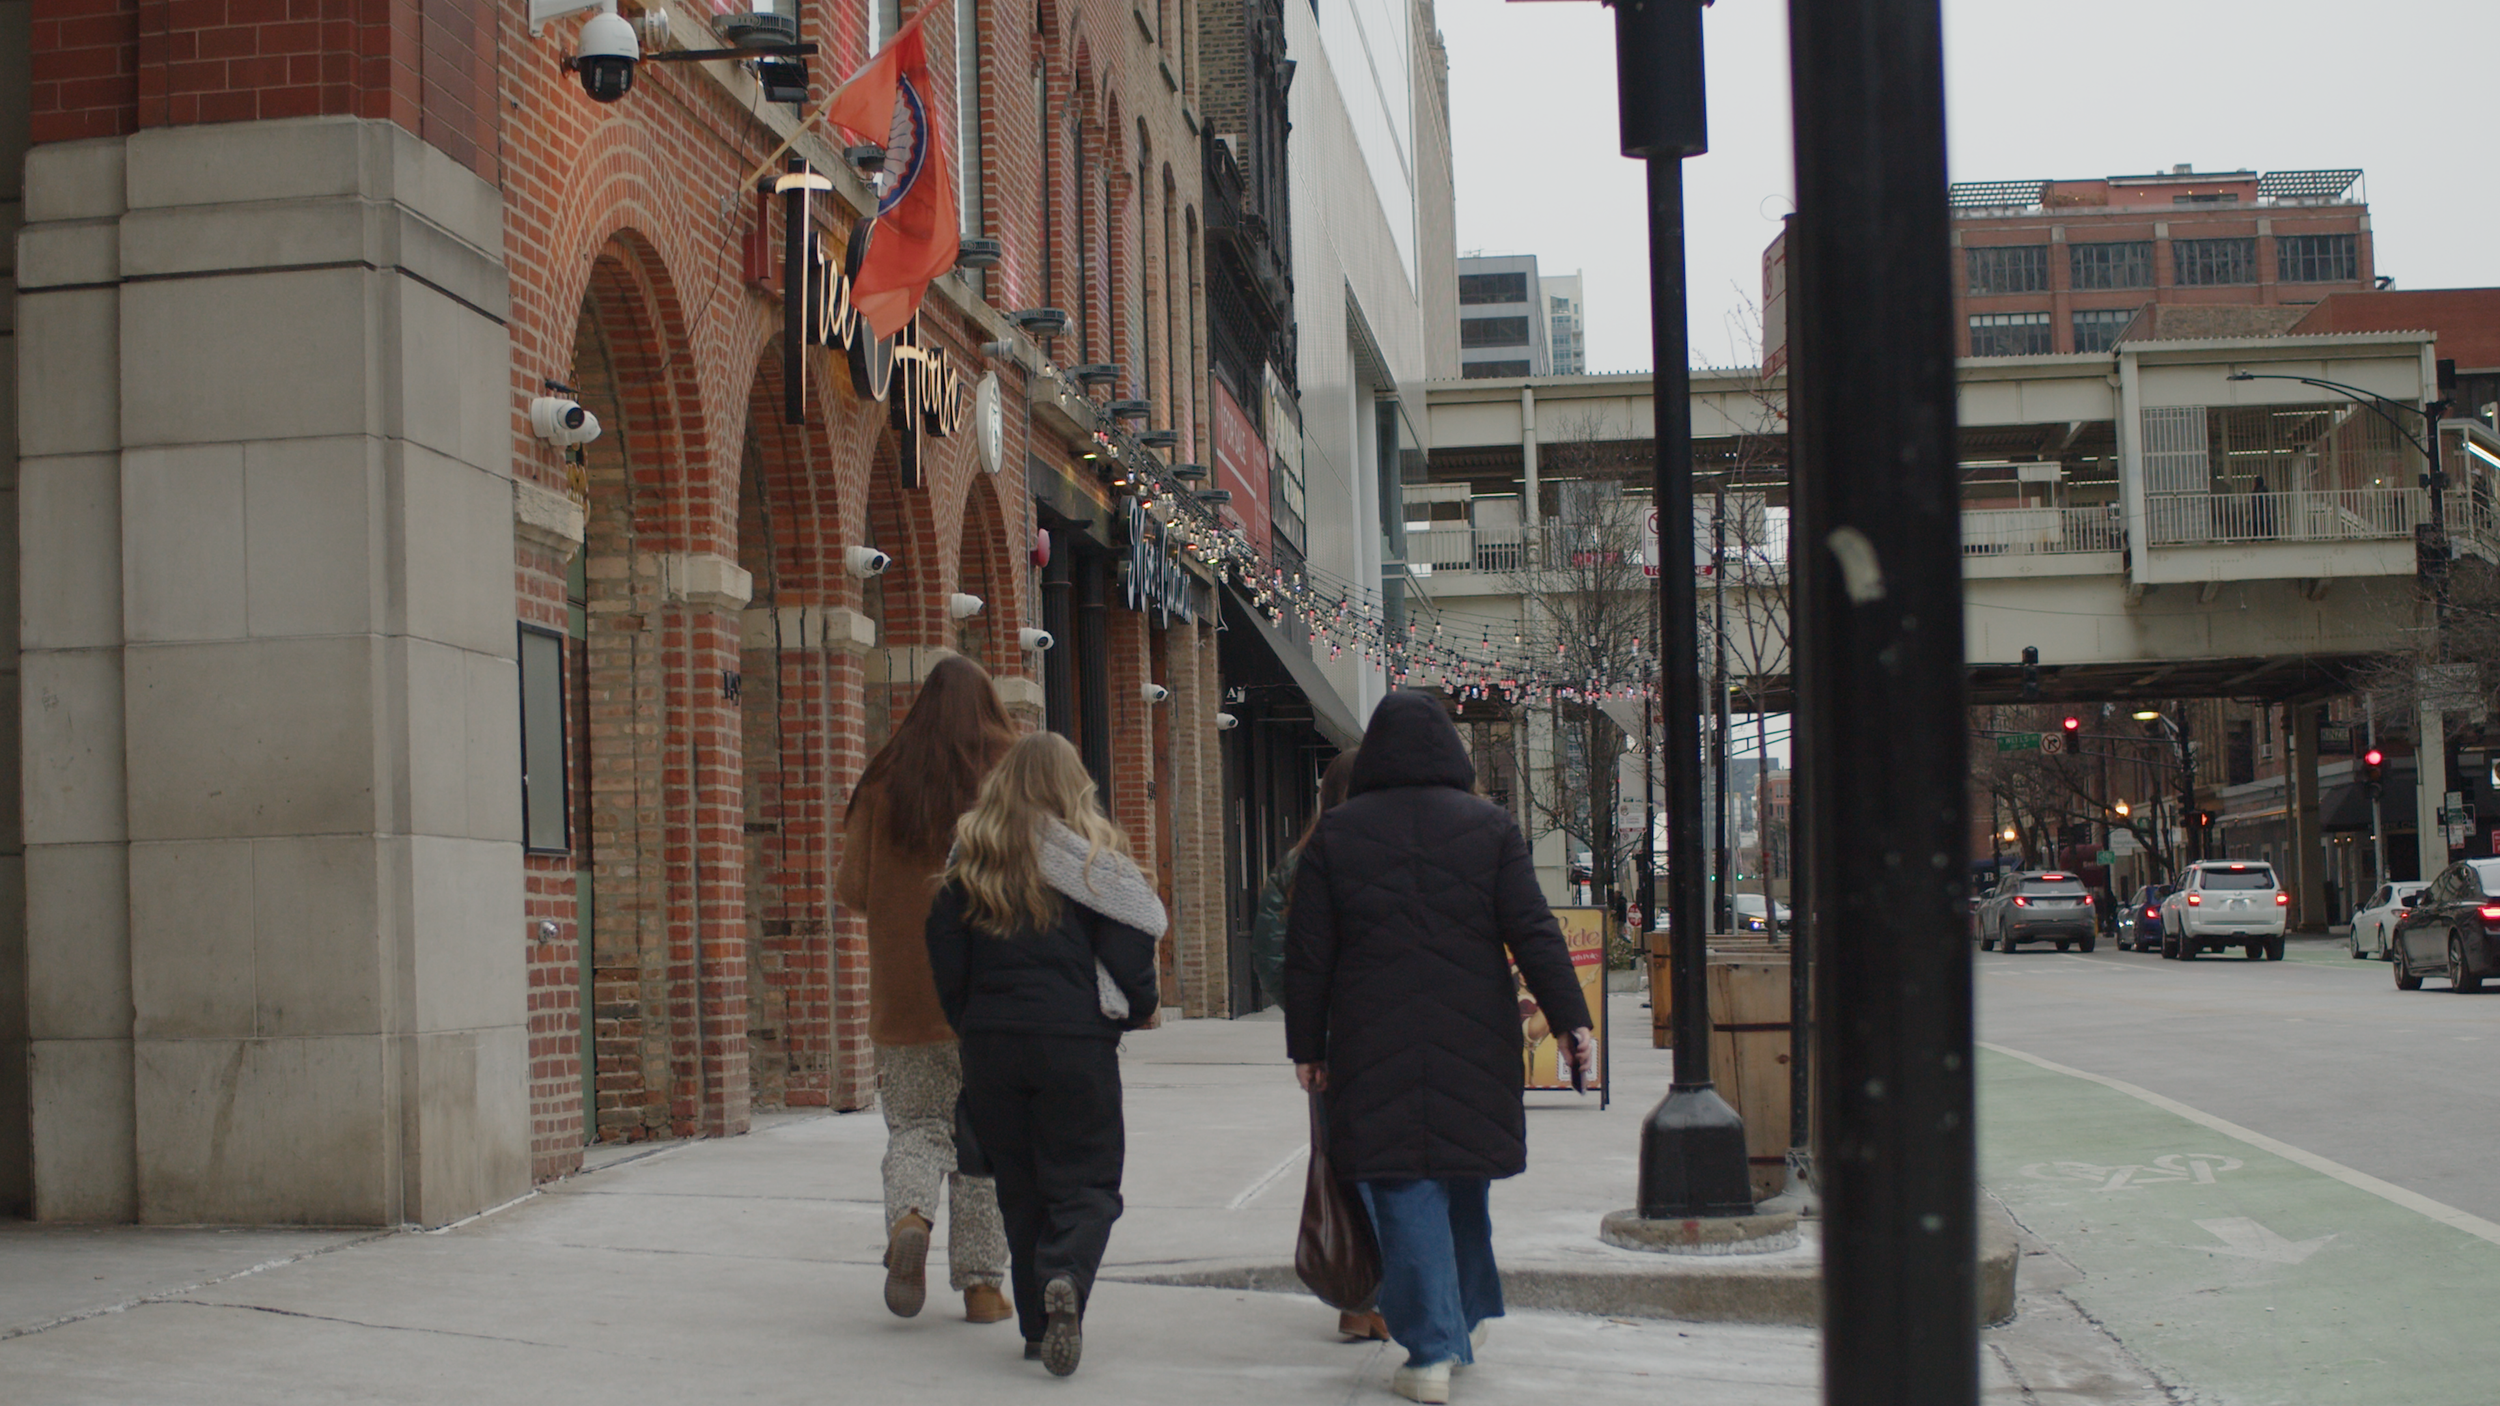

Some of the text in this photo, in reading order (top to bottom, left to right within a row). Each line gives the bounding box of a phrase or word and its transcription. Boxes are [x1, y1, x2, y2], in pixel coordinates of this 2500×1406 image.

[775, 158, 963, 489] Tree House
[1223, 405, 1247, 466] FOR SALE
